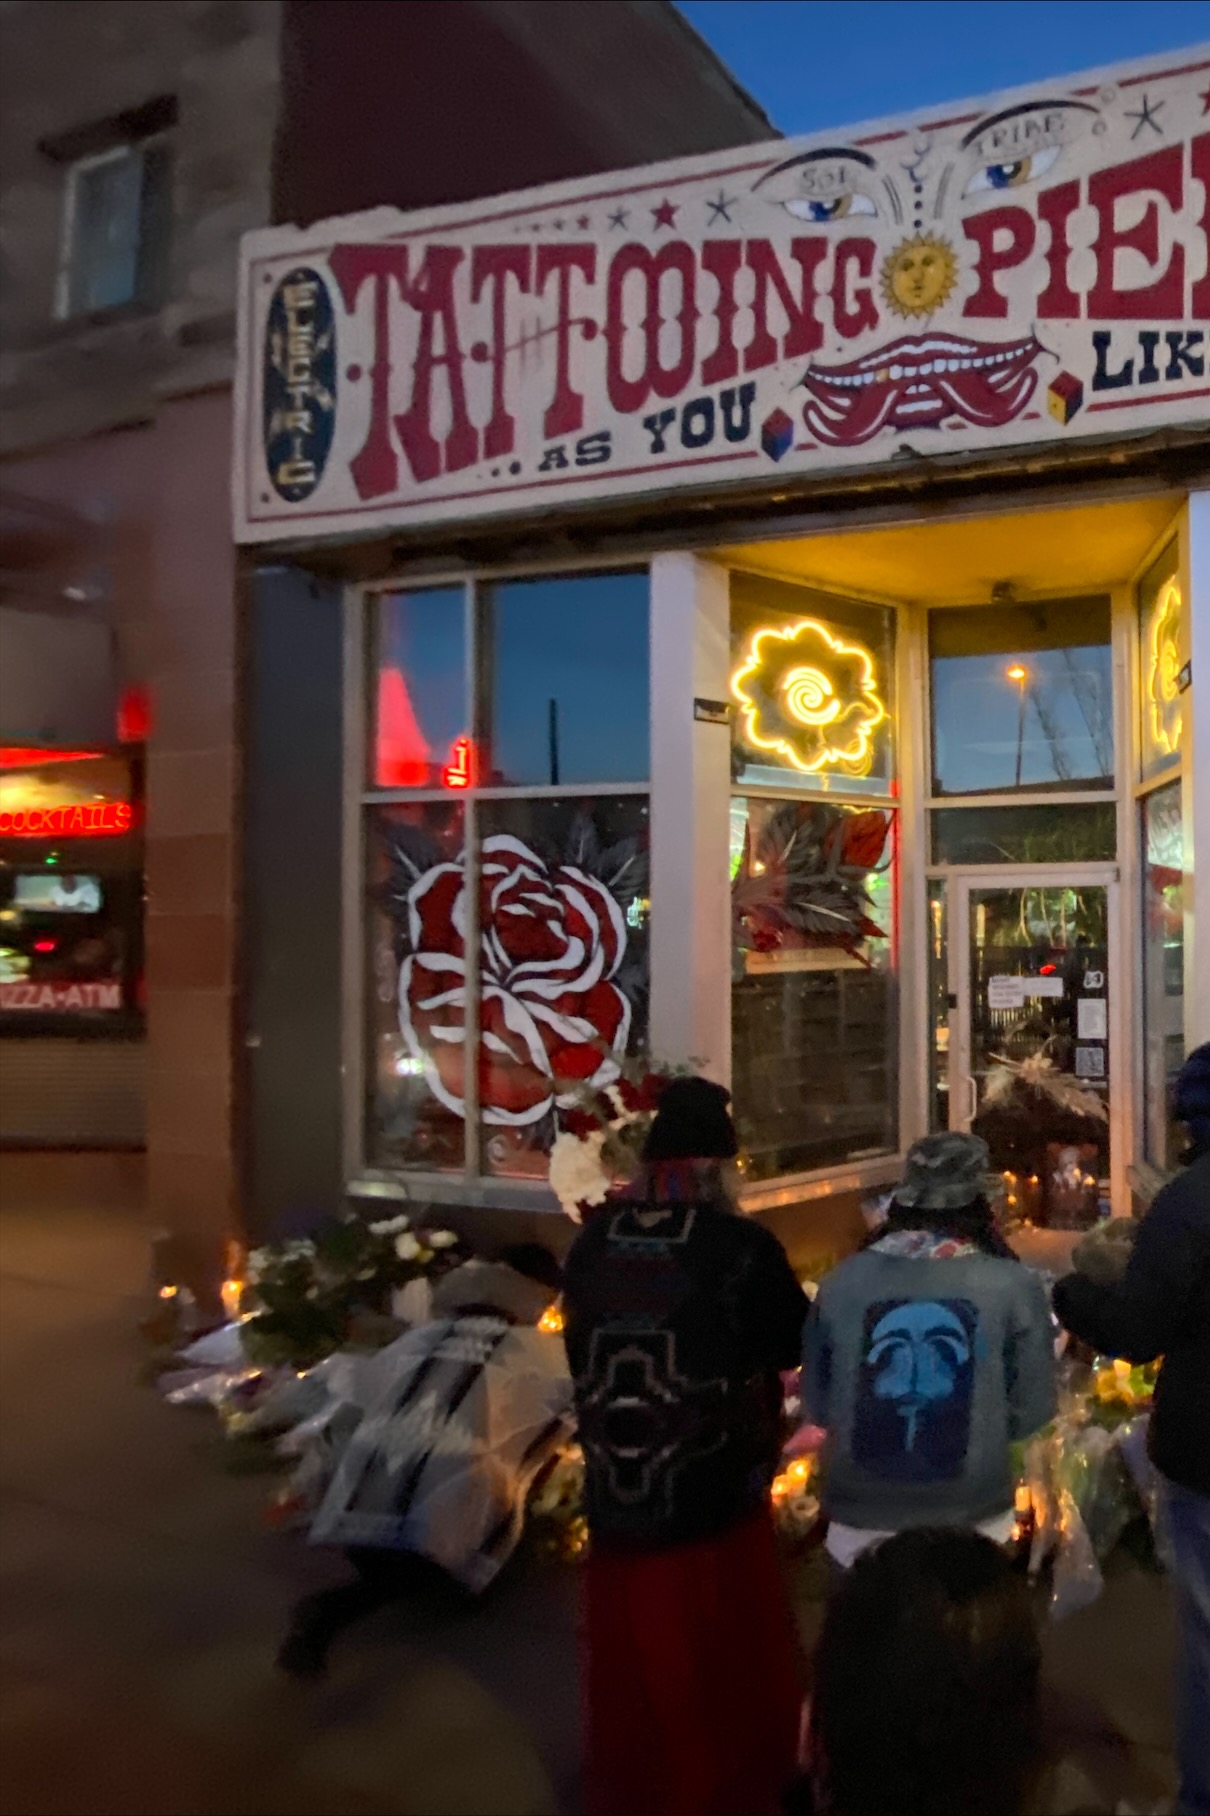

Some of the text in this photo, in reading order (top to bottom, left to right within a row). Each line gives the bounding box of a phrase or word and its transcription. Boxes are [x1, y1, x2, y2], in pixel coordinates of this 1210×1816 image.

[328, 235, 880, 501] TATTOOING
[642, 381, 757, 455] YOU
[0, 803, 132, 832] COCKTAILS
